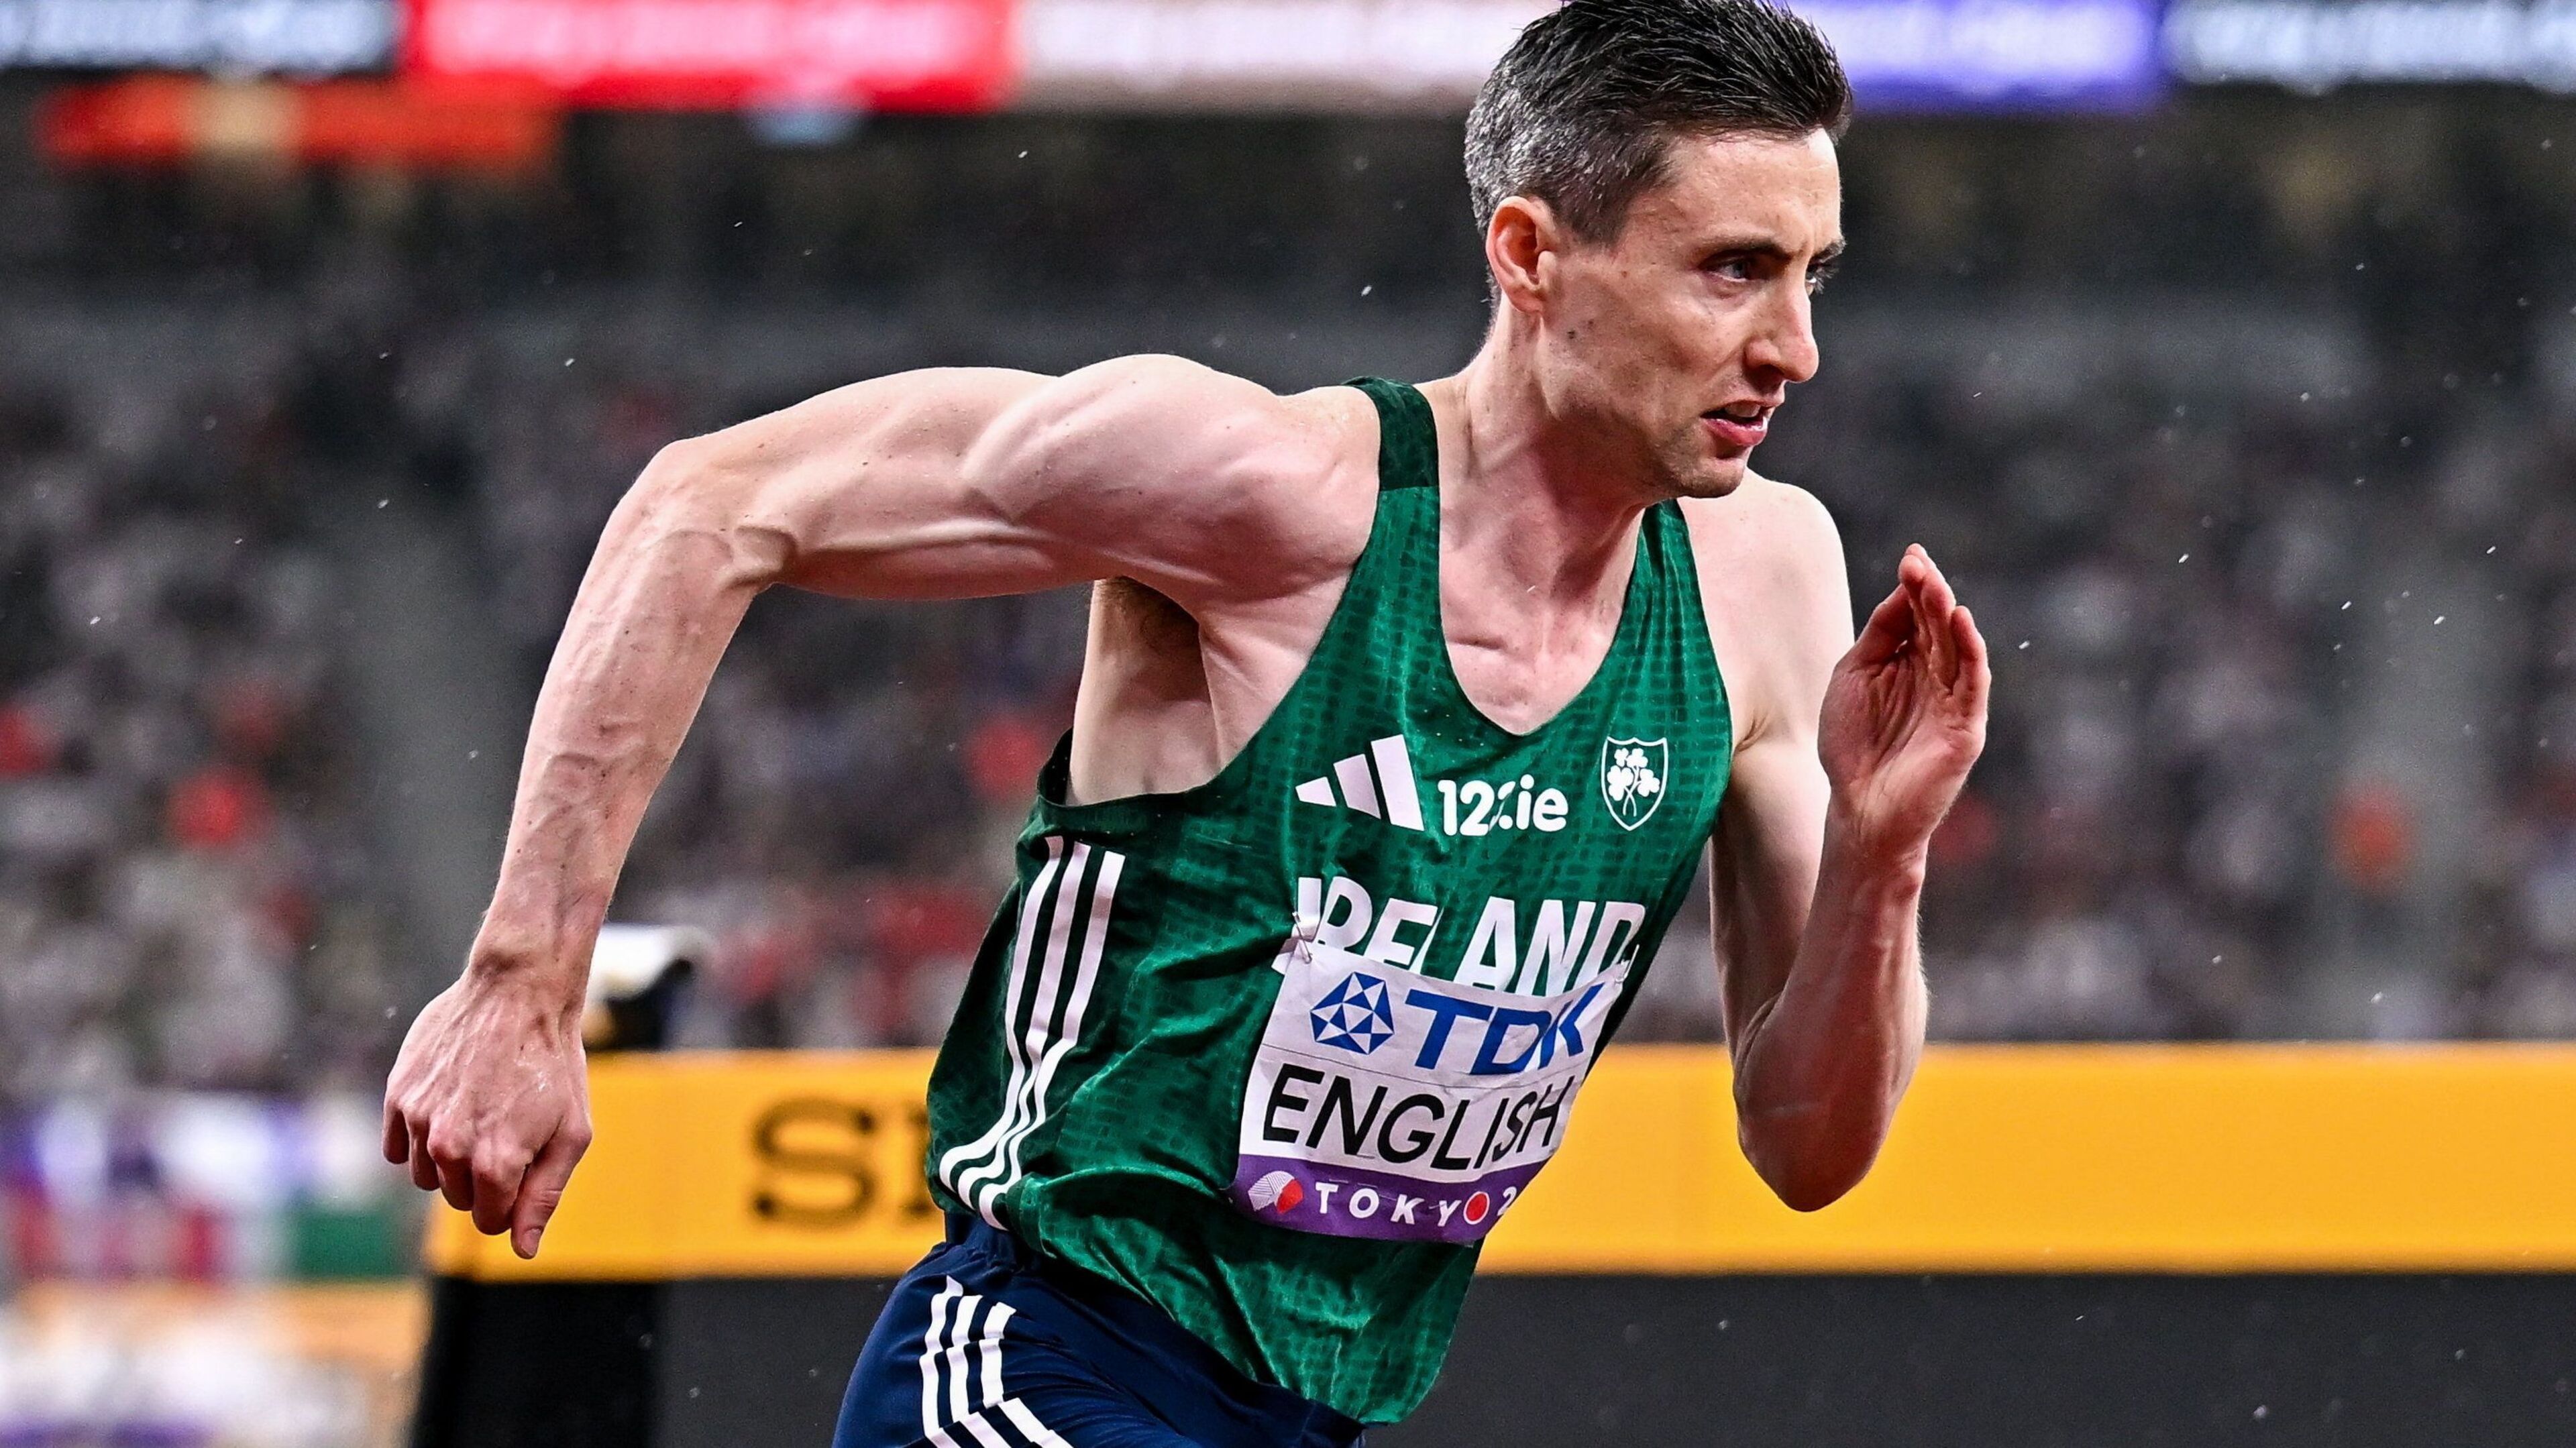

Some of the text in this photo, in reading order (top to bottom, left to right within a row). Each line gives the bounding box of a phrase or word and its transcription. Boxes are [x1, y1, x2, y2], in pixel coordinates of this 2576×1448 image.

[1437, 773, 1569, 837] 12.ie
[1273, 876, 1646, 997] IREAND
[1405, 983, 1606, 1076] TDK
[749, 1095, 936, 1231] S
[1263, 1062, 1576, 1170] ENGLISH
[1315, 1181, 1491, 1227] TOKYO
